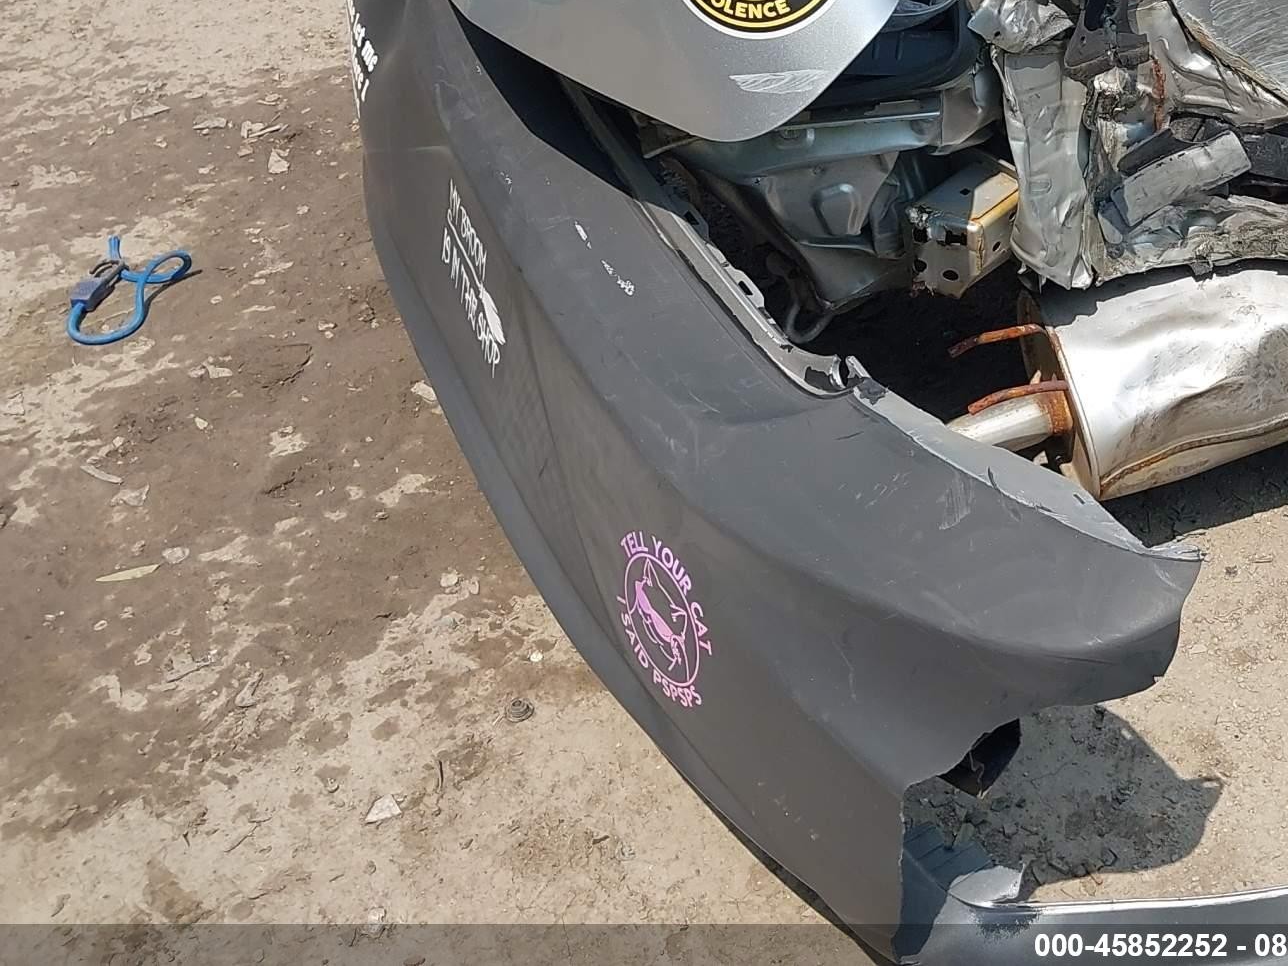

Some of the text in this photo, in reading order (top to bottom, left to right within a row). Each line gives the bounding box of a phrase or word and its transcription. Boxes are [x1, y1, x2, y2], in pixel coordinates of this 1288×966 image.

[449, 177, 487, 283] MY BROOM
[441, 227, 451, 264] IS
[476, 311, 501, 379] SHOP
[616, 595, 703, 708] I SAID PSPSPS
[620, 531, 713, 656] TELL YOUR CAT
